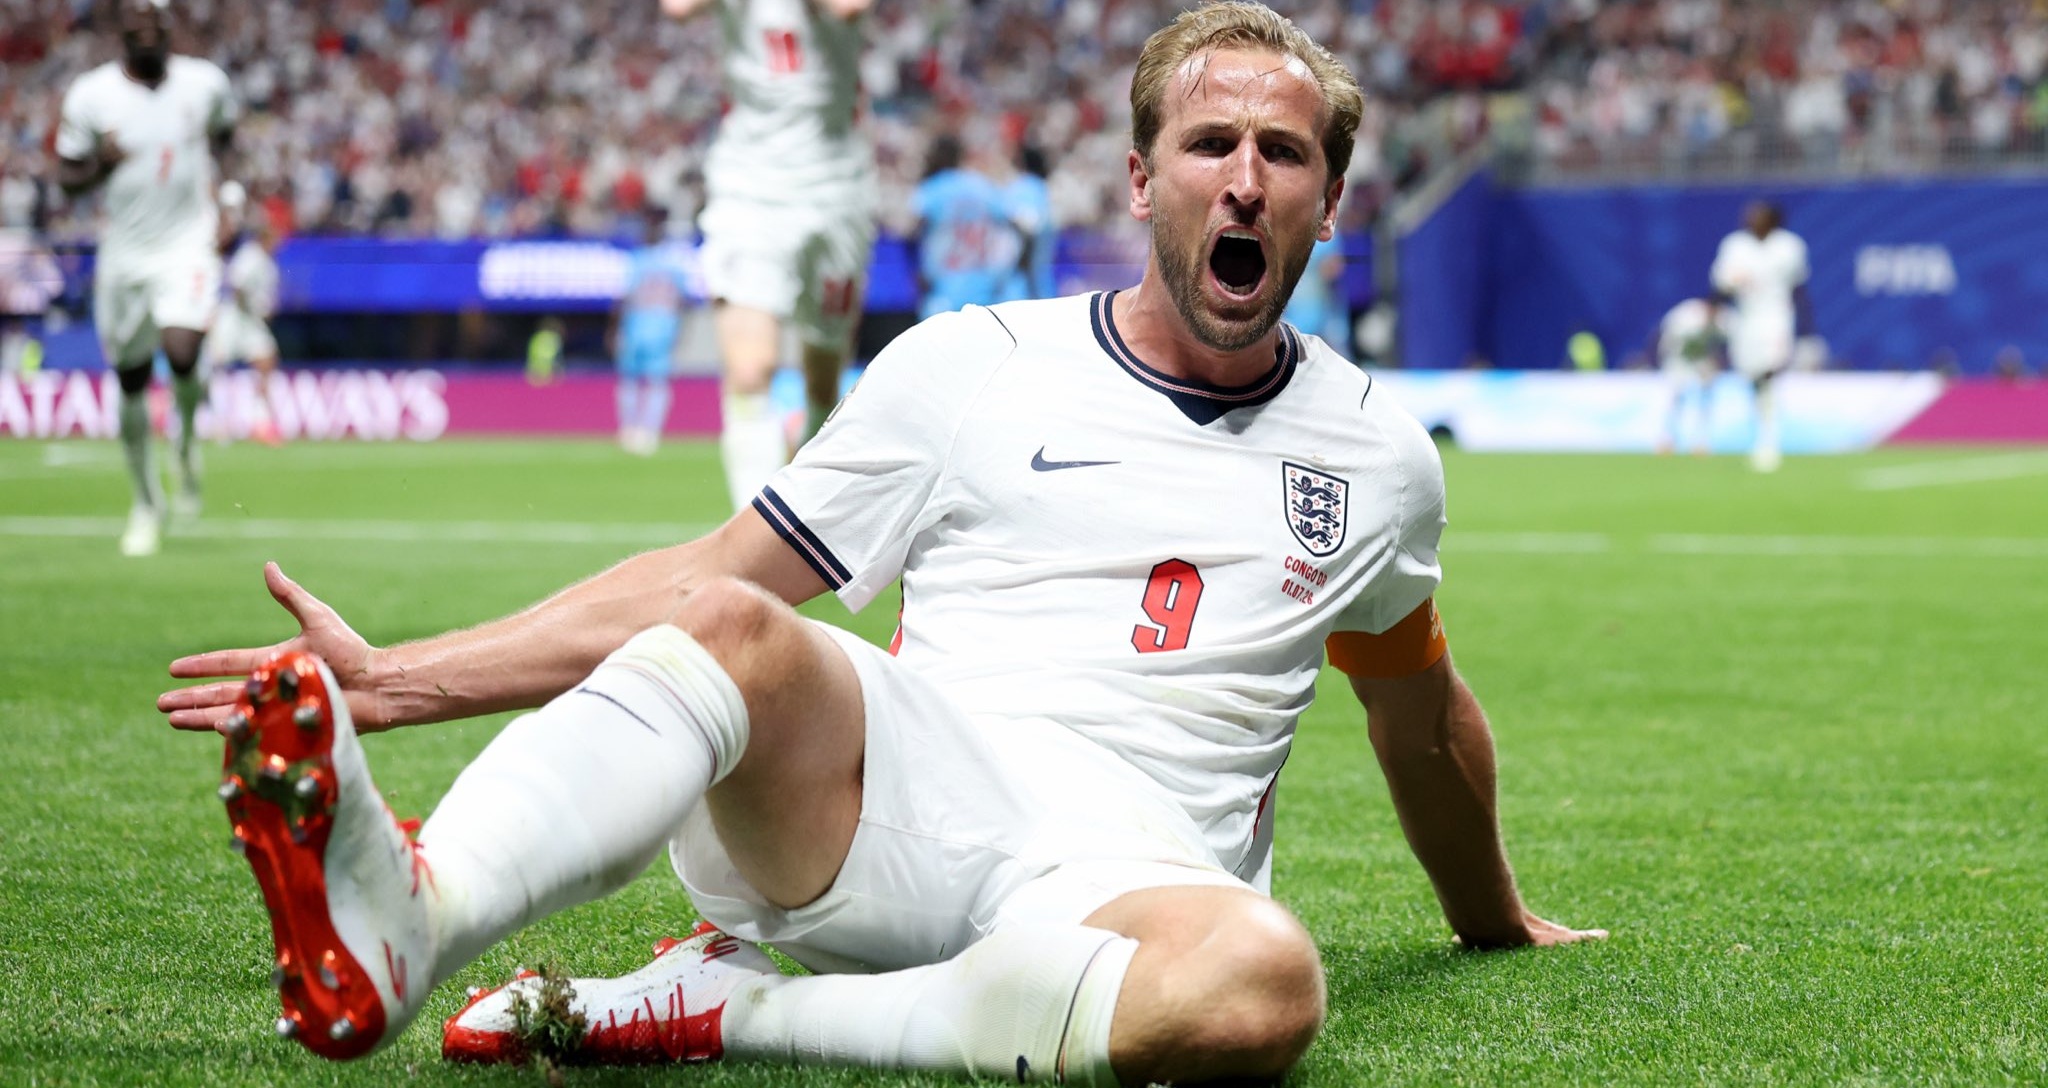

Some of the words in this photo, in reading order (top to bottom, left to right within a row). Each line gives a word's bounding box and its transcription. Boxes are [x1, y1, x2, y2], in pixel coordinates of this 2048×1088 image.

[166, 368, 449, 441] WAYS
[1281, 578, 1314, 605] 01.07.26
[1284, 555, 1319, 583] CONGO
[1315, 571, 1328, 588] DR
[1130, 557, 1205, 654] 9
